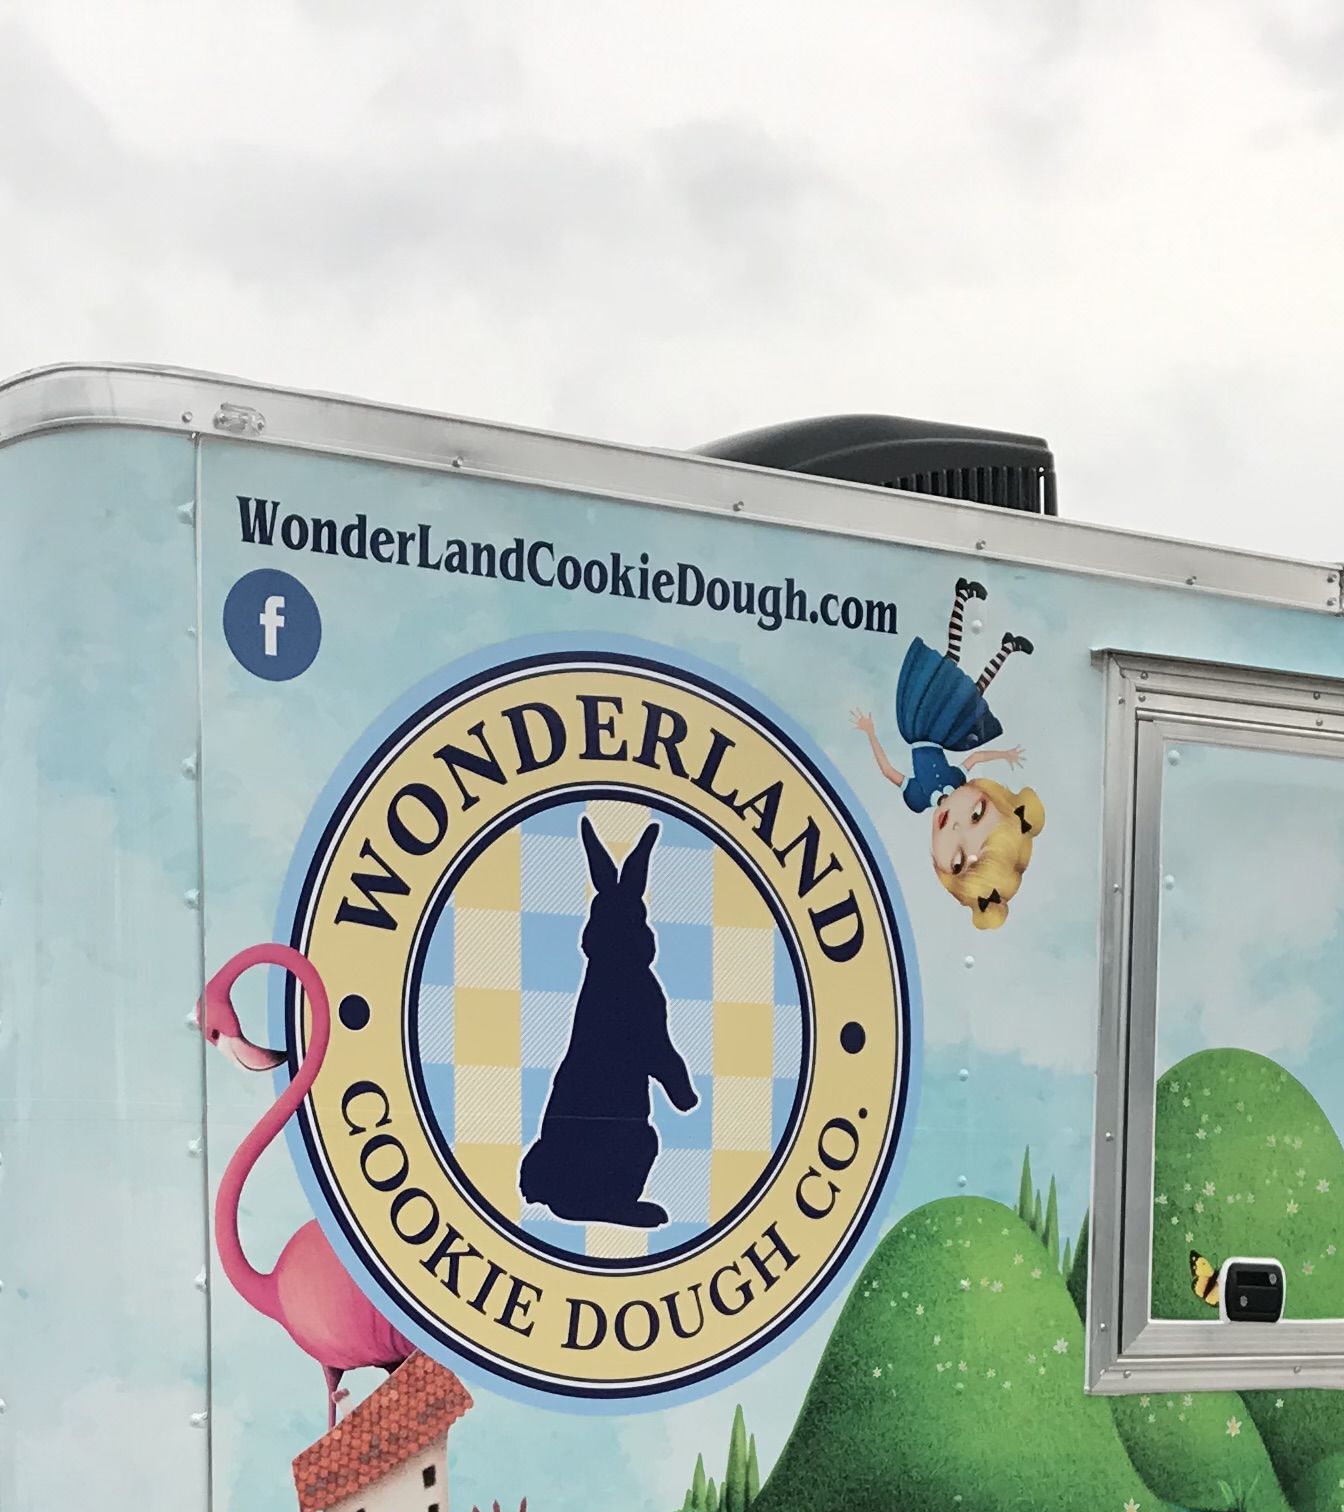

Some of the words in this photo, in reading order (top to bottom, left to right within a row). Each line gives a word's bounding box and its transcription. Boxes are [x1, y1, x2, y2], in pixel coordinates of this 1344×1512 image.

[235, 494, 900, 636] WonderLandCookieDough.com
[334, 694, 866, 964] WONDERLAND
[340, 1080, 544, 1338] COOKIE
[560, 1230, 802, 1352] DOUGH
[793, 1107, 869, 1222] CO.
